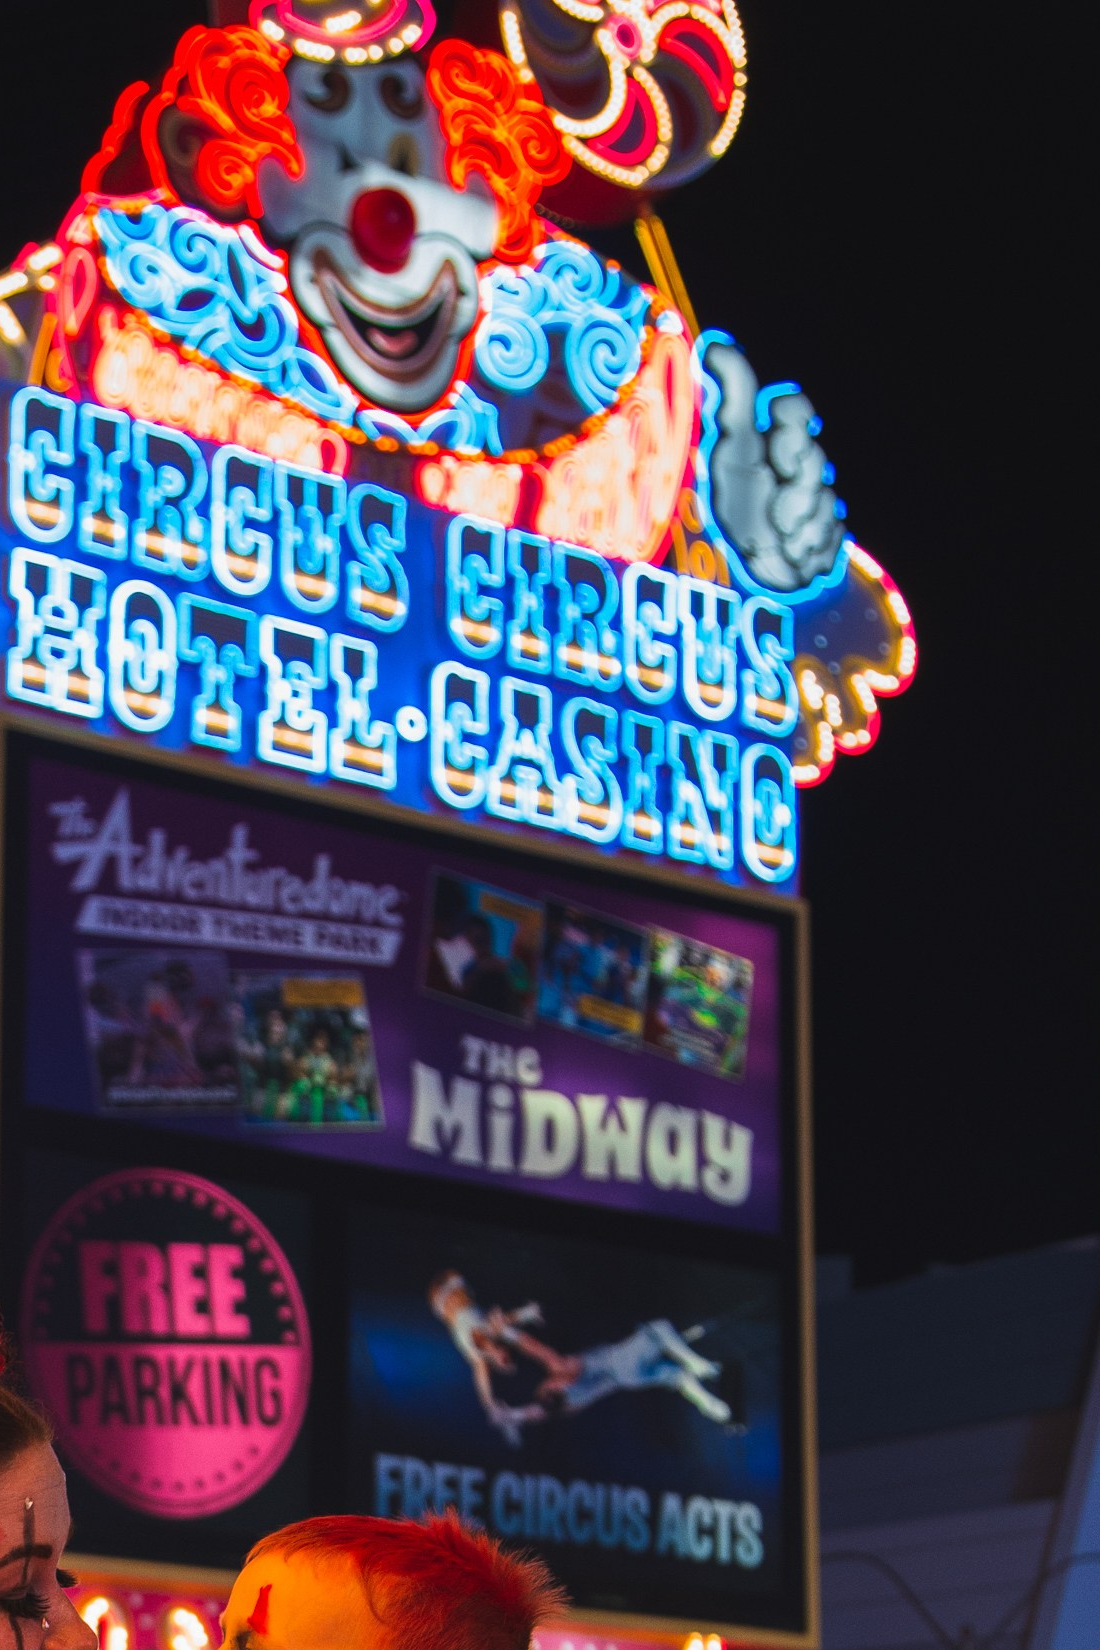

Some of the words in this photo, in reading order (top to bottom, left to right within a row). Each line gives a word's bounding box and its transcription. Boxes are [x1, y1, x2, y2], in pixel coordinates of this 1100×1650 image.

[7, 386, 410, 633] CIRCUS
[446, 513, 800, 738] CIRCUS
[52, 785, 403, 928] Adventuredome
[79, 1240, 251, 1340] FREE
[65, 1354, 284, 1427] PARKING
[374, 1453, 487, 1528] FREE
[492, 1470, 652, 1554] CIRCUS
[656, 1490, 765, 1570] ACTS
